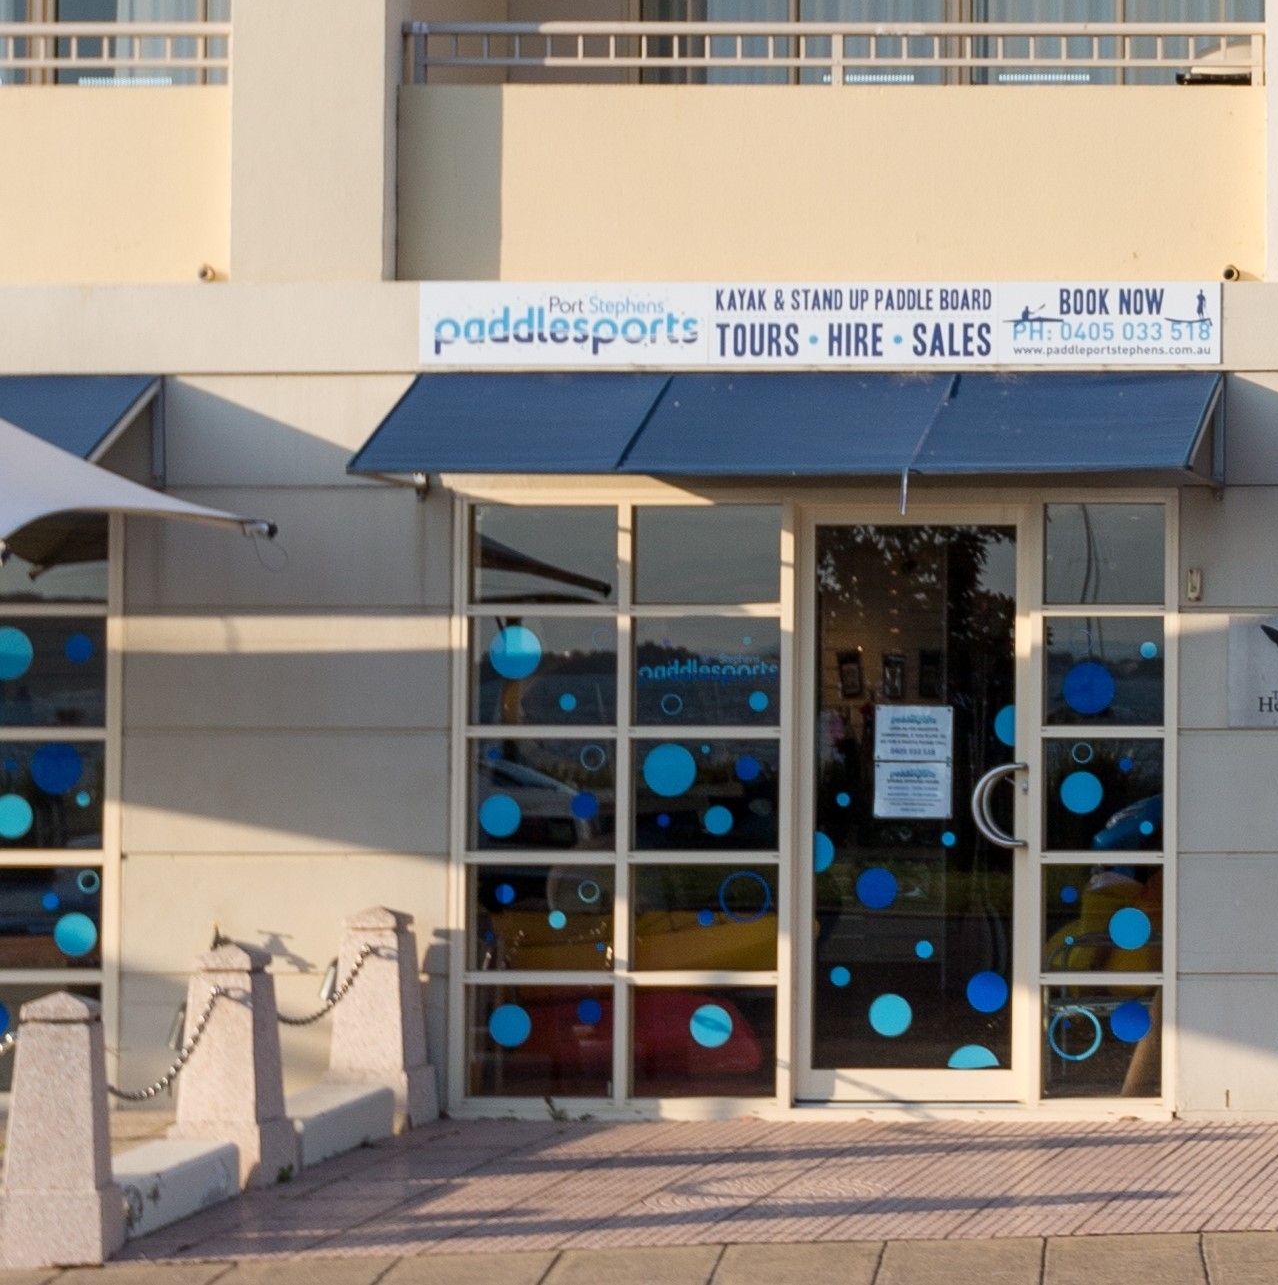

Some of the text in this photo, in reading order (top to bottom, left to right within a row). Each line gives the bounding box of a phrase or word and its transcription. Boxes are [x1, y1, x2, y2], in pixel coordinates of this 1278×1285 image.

[549, 296, 665, 318] Port Stephens
[715, 289, 992, 311] KAYAK & STAND UP PADDLE BOARD
[1059, 288, 1165, 315] BOOK NOW
[434, 306, 699, 356] paddlesports
[715, 322, 992, 358] TOURS HIRE SALES
[1013, 322, 1211, 341] PH: 0405 033 518
[1013, 344, 1211, 357] www.paddleportstephens.com.au
[638, 658, 779, 687] paddlesports
